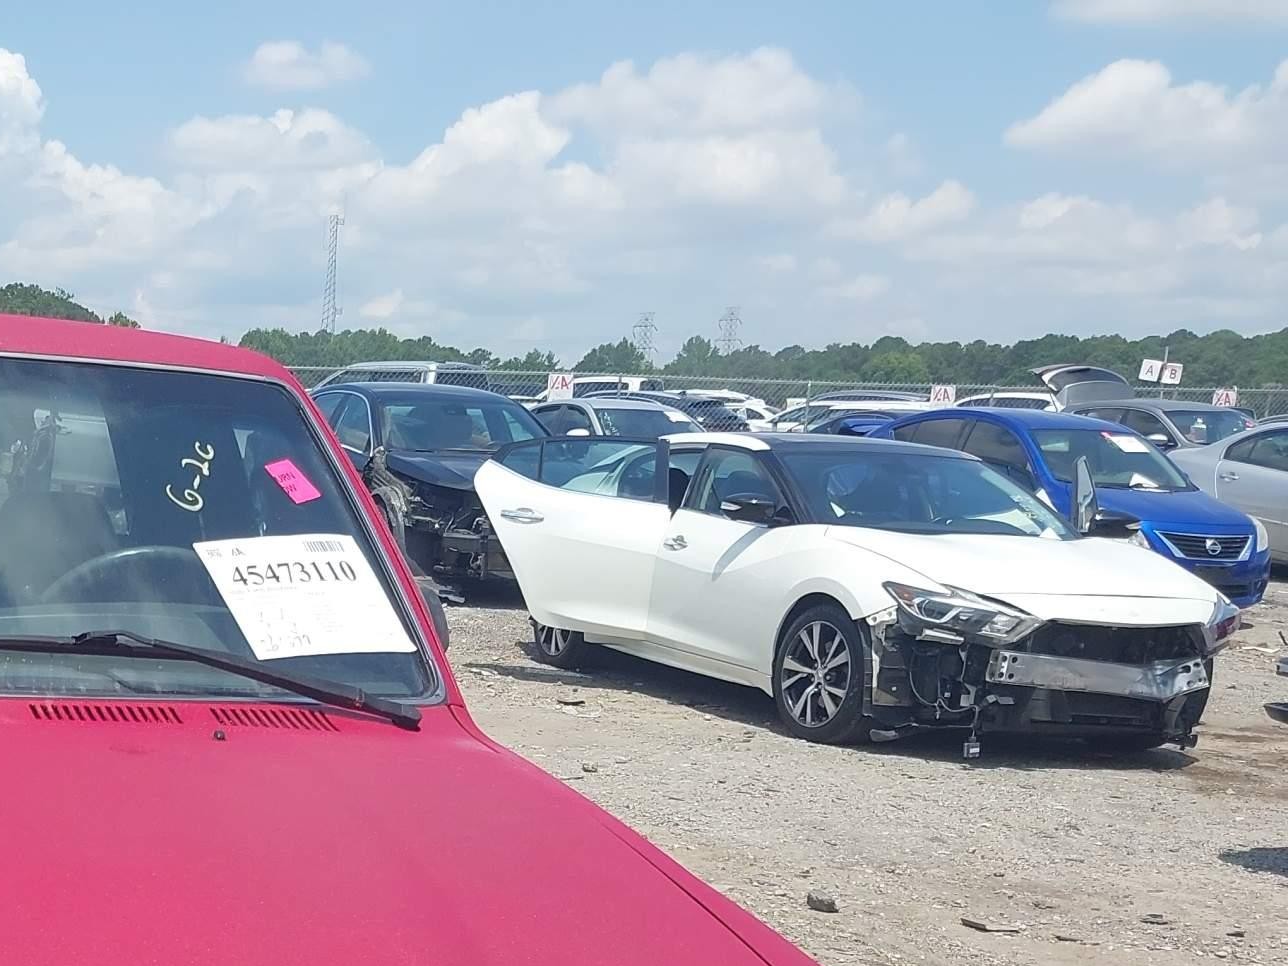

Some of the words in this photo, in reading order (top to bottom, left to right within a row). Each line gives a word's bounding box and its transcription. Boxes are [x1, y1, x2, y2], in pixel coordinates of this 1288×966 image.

[1144, 364, 1154, 377] A
[1169, 368, 1178, 380] B
[232, 559, 358, 587] 45473110
